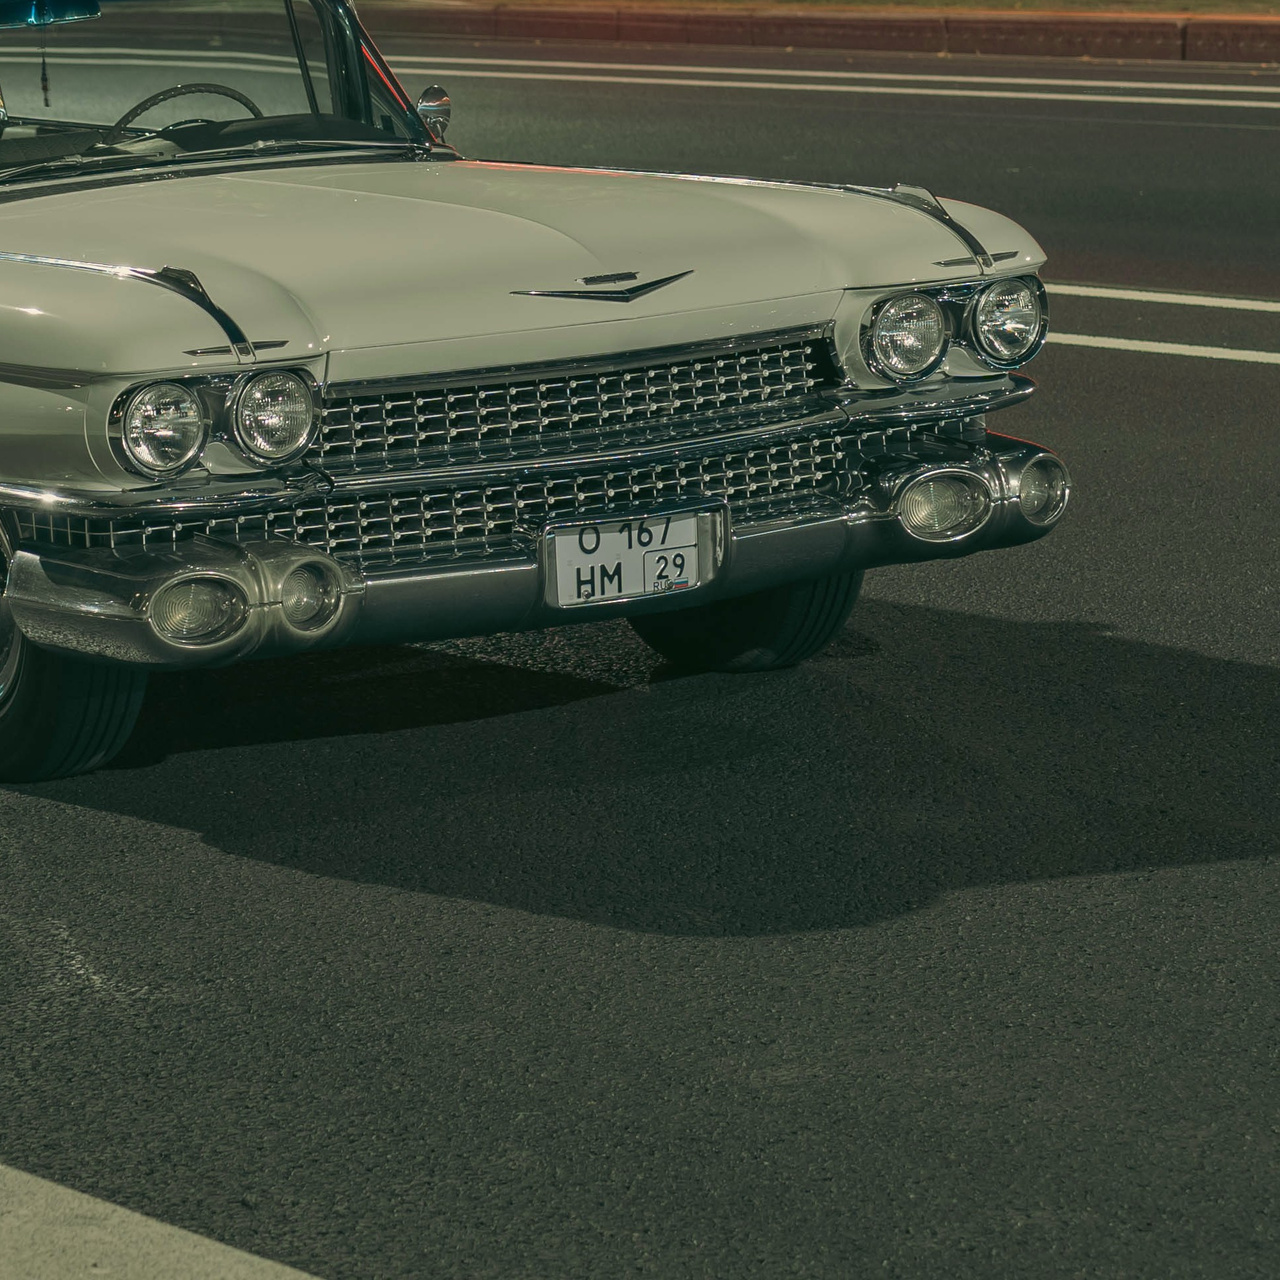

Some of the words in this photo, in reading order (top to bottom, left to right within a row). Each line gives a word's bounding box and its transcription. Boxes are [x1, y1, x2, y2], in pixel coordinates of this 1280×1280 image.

[578, 526, 601, 554] O
[618, 516, 672, 549] 167
[576, 561, 623, 599] HM
[656, 552, 685, 580] 29
[653, 579, 673, 592] RU
